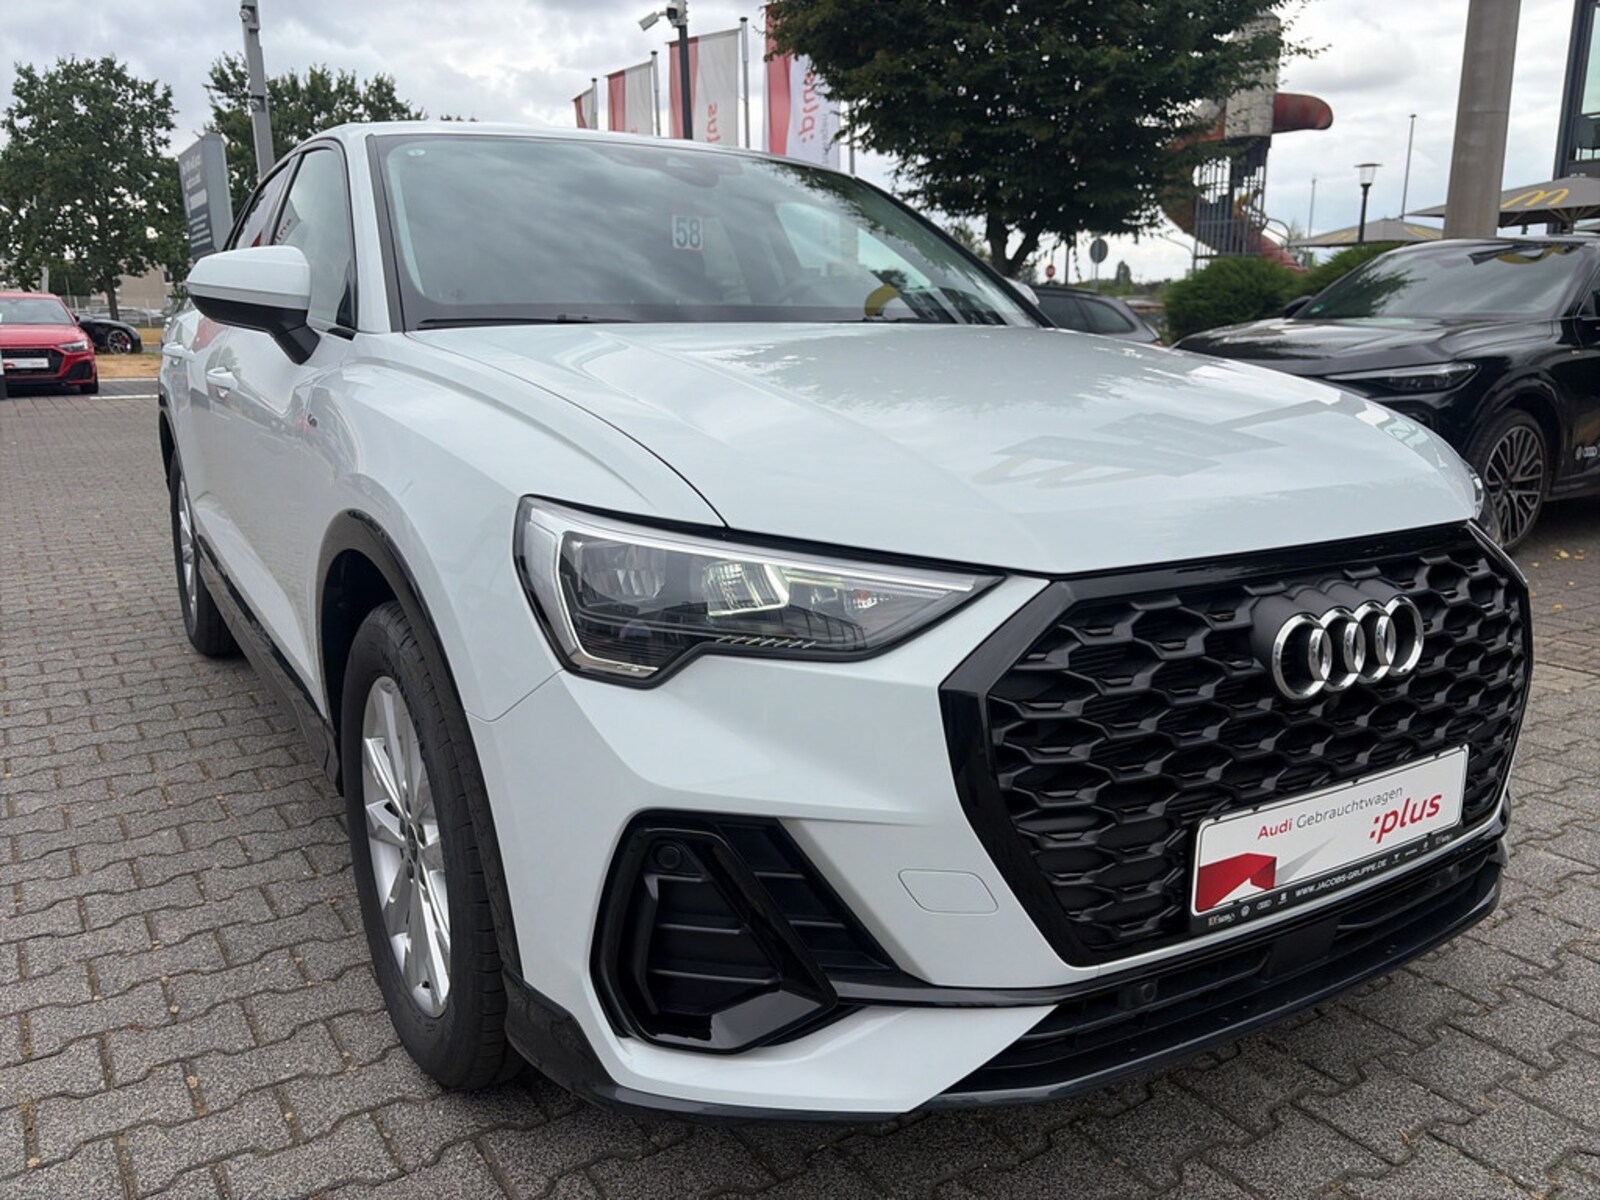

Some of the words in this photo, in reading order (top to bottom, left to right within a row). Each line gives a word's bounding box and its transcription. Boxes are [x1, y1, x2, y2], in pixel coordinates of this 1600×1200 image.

[676, 217, 701, 248] 58
[1257, 818, 1294, 840] Audi
[1296, 786, 1404, 830] Gebrauchtwagen
[1369, 794, 1442, 844] :plus
[1294, 859, 1388, 898] WWW.JACOBS-GRUPPE.DE
